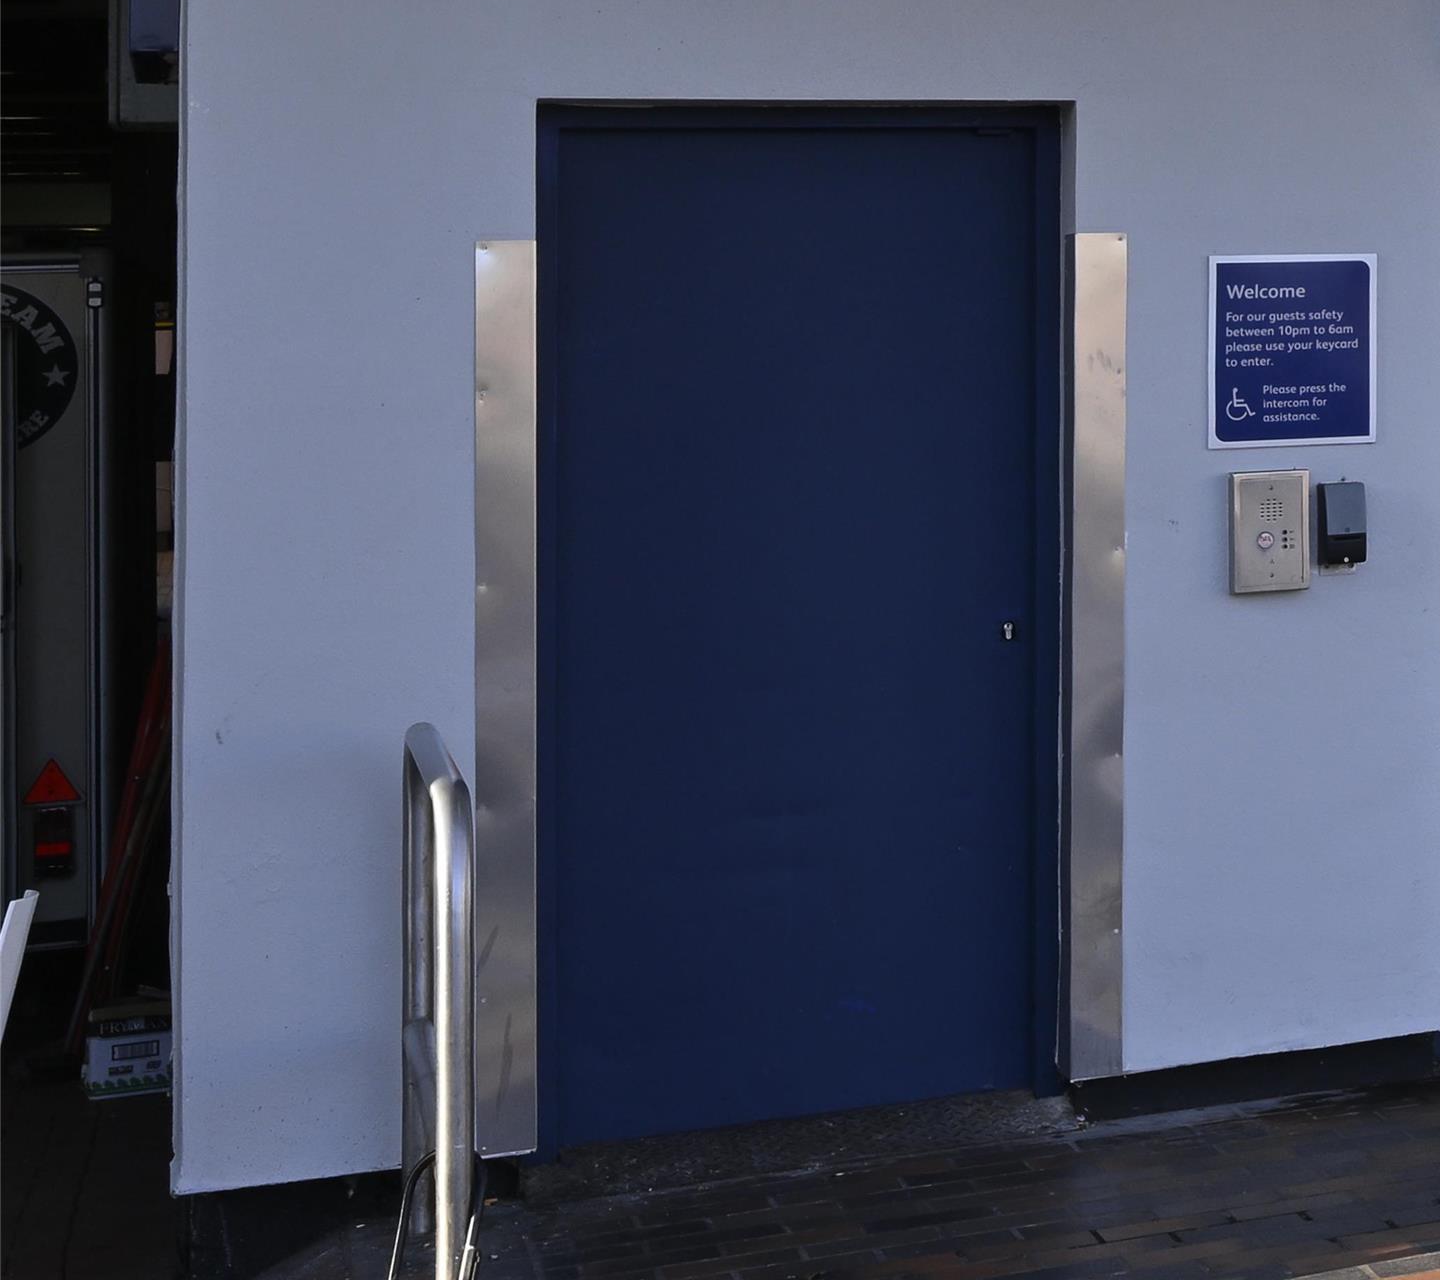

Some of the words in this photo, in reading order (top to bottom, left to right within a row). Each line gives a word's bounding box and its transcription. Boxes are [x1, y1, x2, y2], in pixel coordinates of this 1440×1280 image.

[1226, 284, 1306, 299] Welcome
[1226, 312, 1243, 322] For
[1247, 312, 1266, 321] our
[1269, 311, 1306, 324] guests
[1308, 309, 1344, 321] safety
[1226, 327, 1274, 337] between
[1279, 326, 1310, 337] 10pm
[1314, 326, 1326, 334] to
[1328, 324, 1353, 334] 6am
[1226, 342, 1262, 354] please
[1265, 342, 1285, 351] use
[1288, 341, 1313, 352] your
[1316, 339, 1358, 351] keycard
[1226, 358, 1238, 367] to
[1241, 358, 1274, 366] enter.
[1263, 385, 1297, 394] Please
[1299, 384, 1326, 395] press
[1329, 382, 1346, 392] the
[1263, 399, 1309, 408] intercom
[1312, 397, 1327, 407] for
[1263, 412, 1320, 422] assistance.
